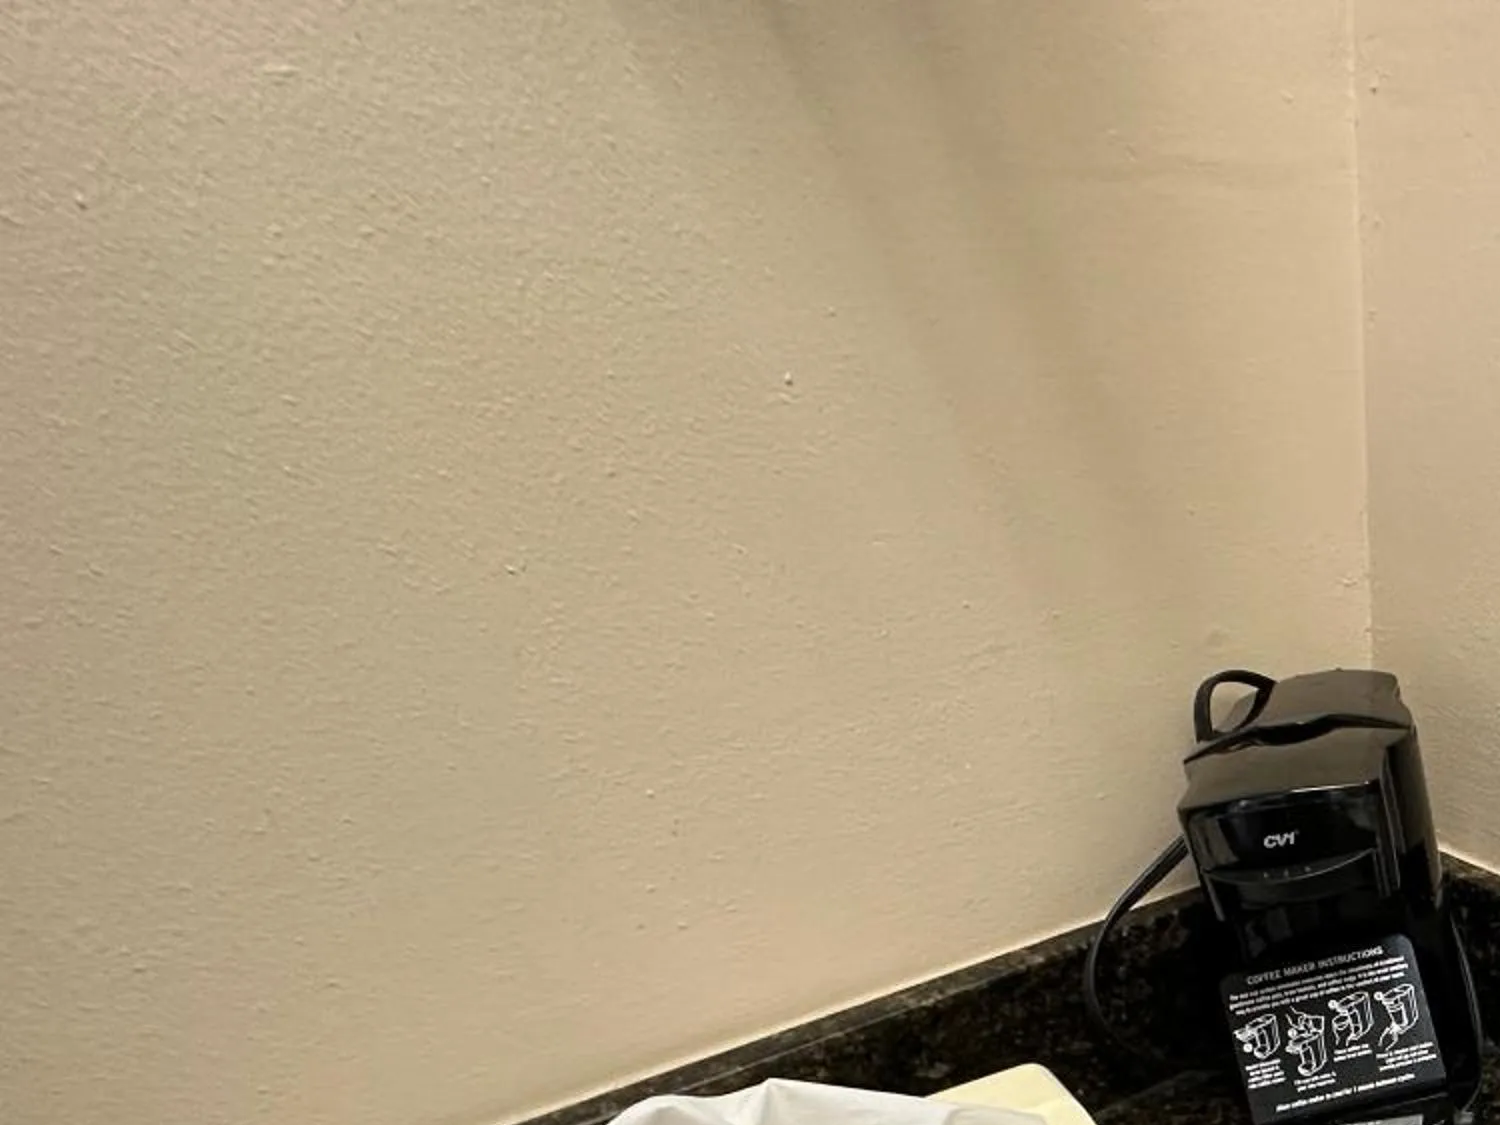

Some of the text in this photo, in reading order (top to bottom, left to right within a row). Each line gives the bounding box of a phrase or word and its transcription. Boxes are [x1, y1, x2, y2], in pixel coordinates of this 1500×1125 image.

[1246, 945, 1384, 986] COFFEE MAKER INSTRUCTIONS
